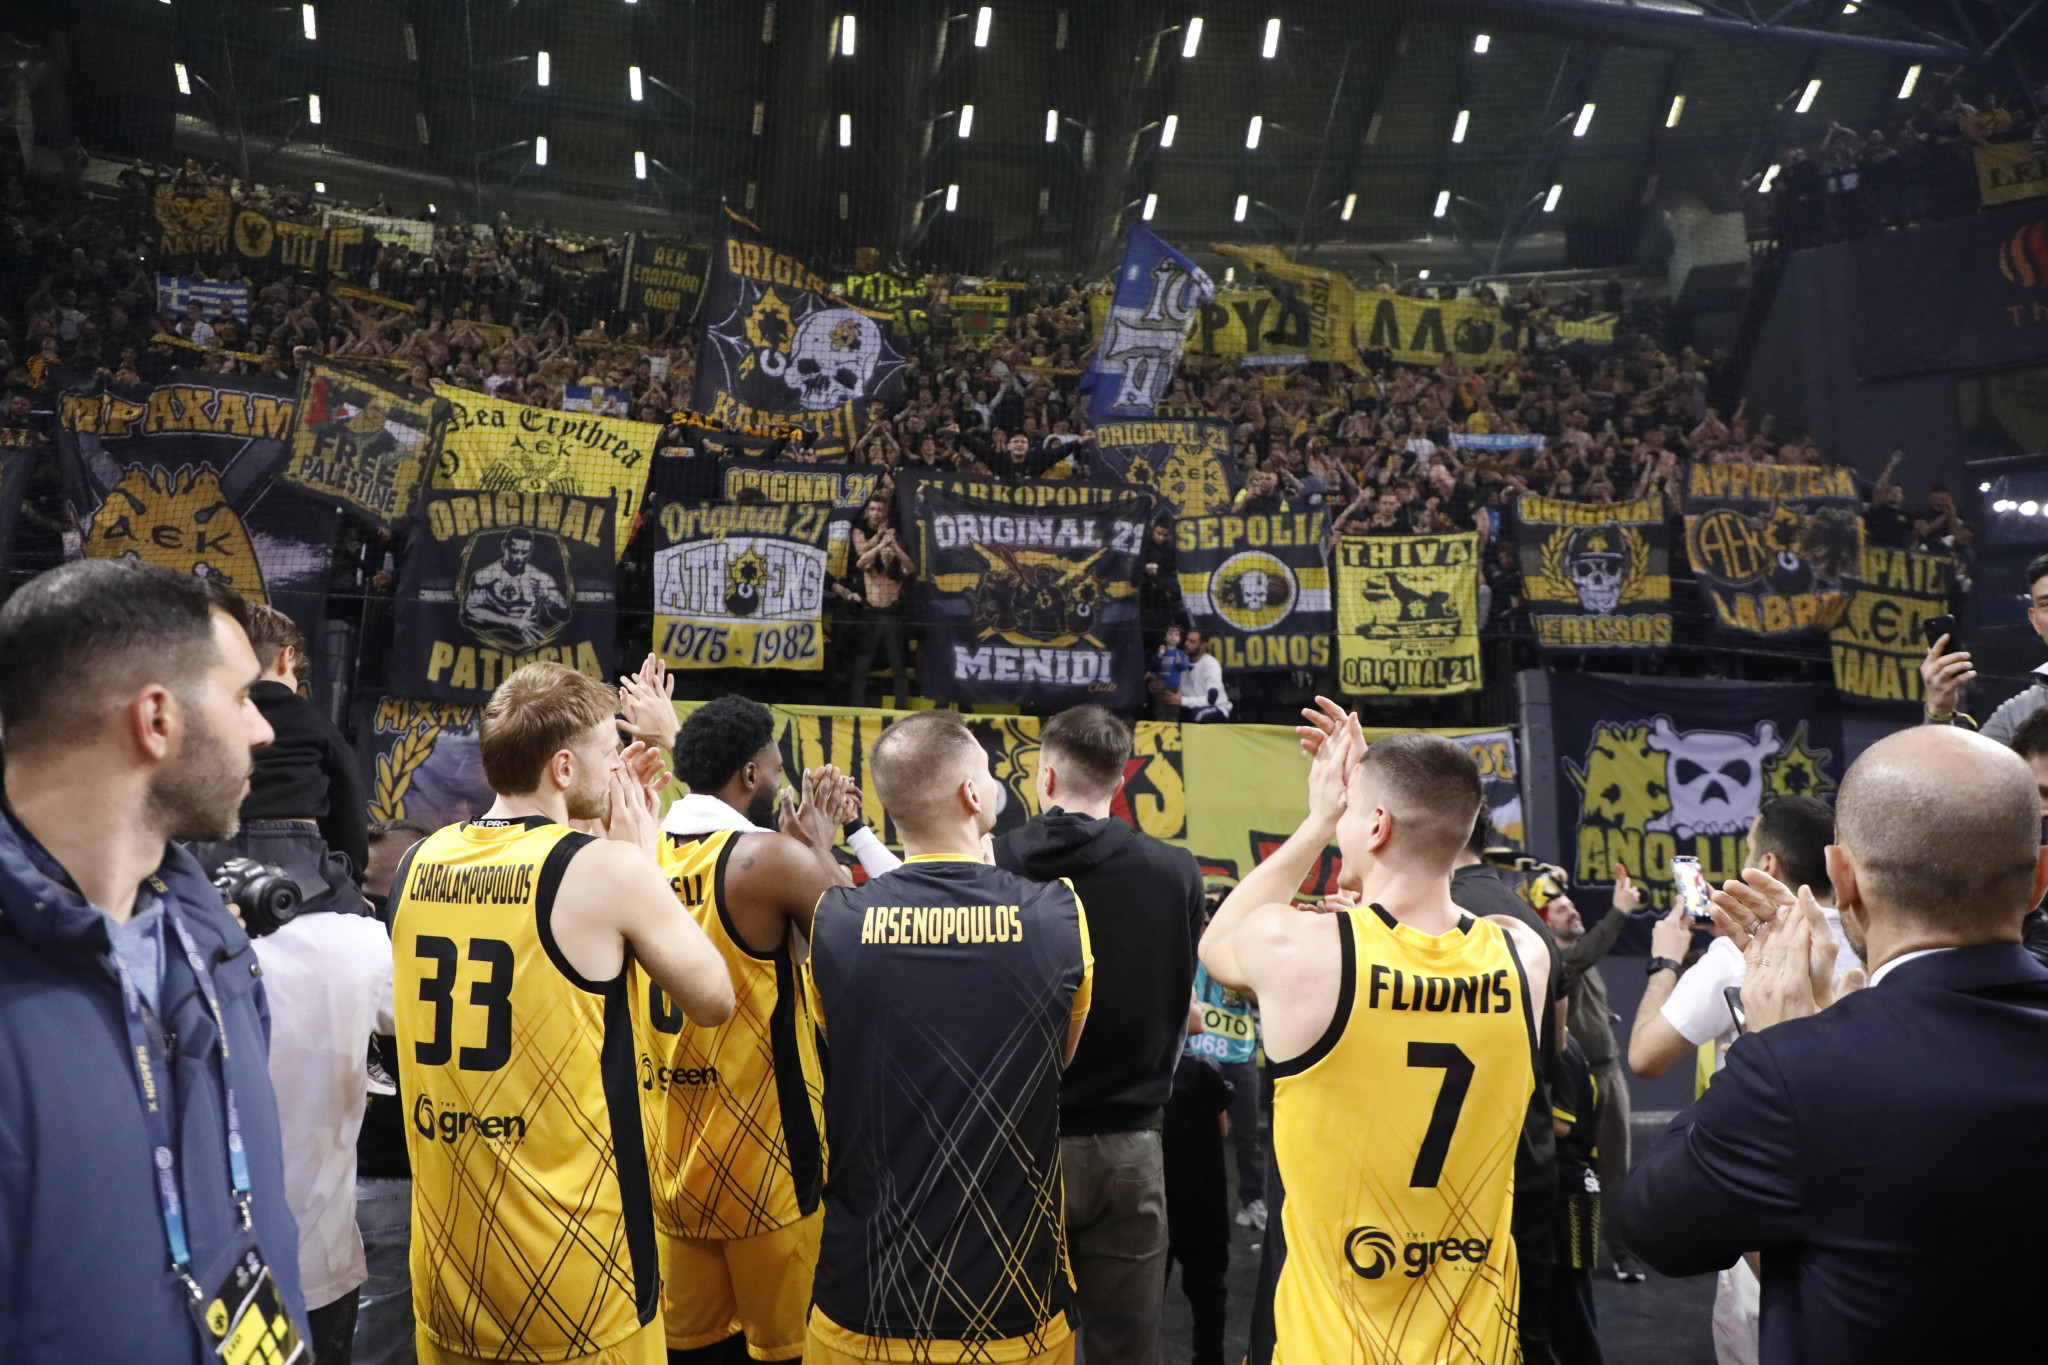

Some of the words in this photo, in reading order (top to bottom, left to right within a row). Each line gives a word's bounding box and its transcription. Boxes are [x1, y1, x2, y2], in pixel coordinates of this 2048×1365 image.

[520, 408, 643, 469] Erythrea
[1097, 422, 1200, 449] ORIGINAL
[1206, 426, 1229, 452] 21
[314, 432, 397, 487] FREE
[301, 456, 398, 512] PALESTINE
[725, 467, 842, 507] ORIGINAL
[843, 474, 877, 507] 21
[427, 493, 605, 548] ORIGINAL
[660, 502, 790, 543] Original
[790, 503, 831, 544] 21
[934, 514, 1101, 548] ORIGINAL
[1111, 520, 1145, 555] 21
[1342, 539, 1471, 567] THIVA
[662, 622, 729, 664] 1975
[751, 622, 816, 665] 1982
[954, 645, 1113, 684] MENIDI
[1578, 827, 1677, 882] ANO
[410, 862, 534, 906] CHARALAMPOPOULOS
[861, 905, 1023, 945] ARSENOPOULOS
[415, 935, 515, 1072] 33
[1369, 963, 1512, 1014] FLIONIS
[438, 1107, 527, 1144] green
[1406, 1041, 1476, 1189] 7
